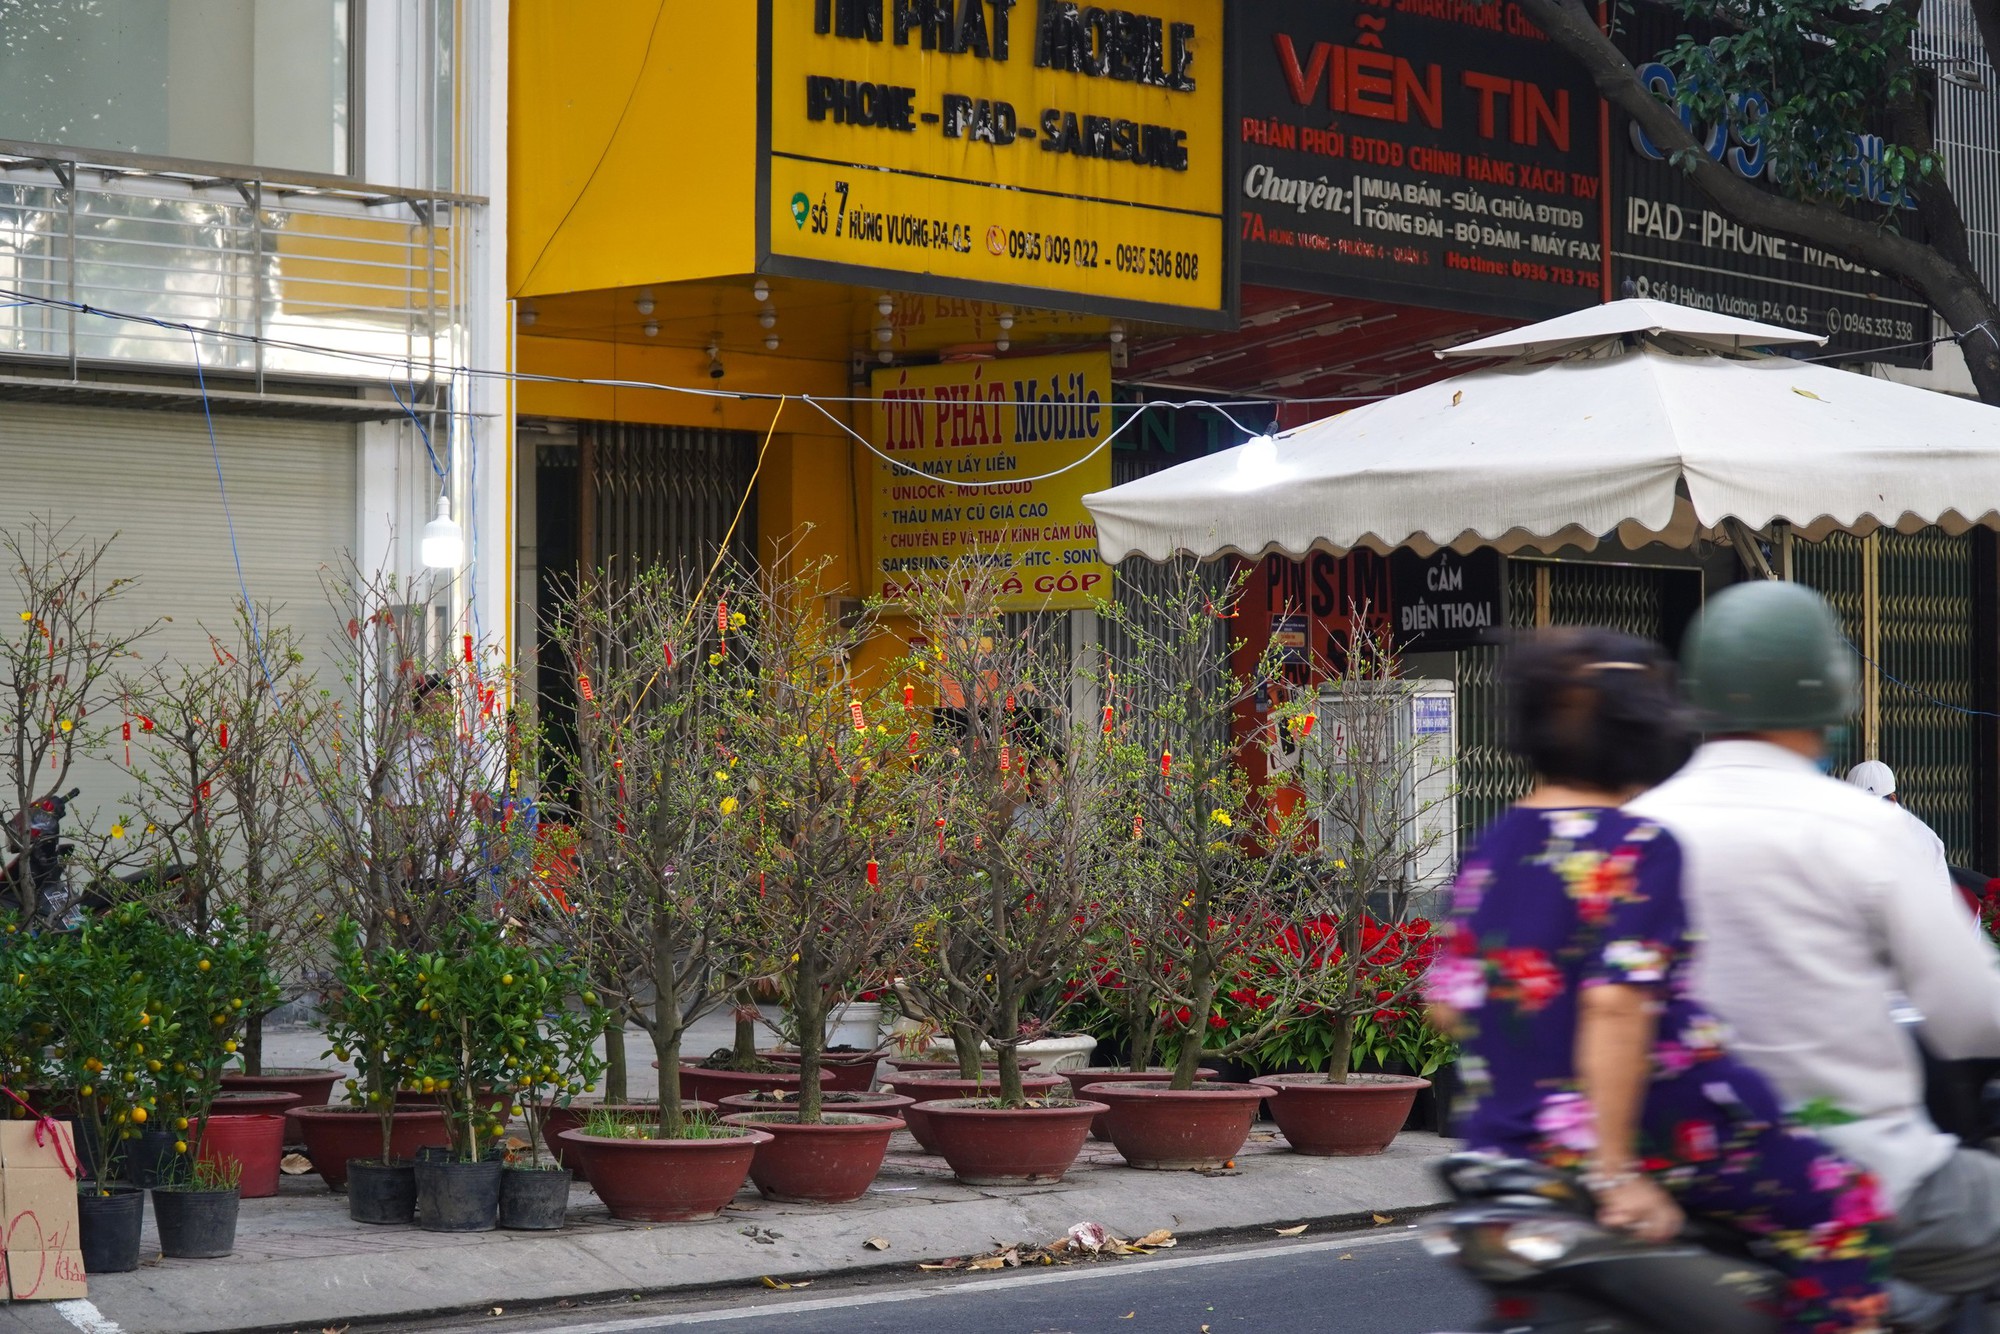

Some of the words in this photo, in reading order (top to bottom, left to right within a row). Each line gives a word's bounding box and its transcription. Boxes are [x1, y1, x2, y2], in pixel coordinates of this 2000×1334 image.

[1274, 13, 1443, 129] VIỄN
[1461, 69, 1570, 151] TIN
[806, 75, 916, 133] IPHONE
[942, 94, 1016, 145] IPAD
[1040, 109, 1188, 171] SAMSUNG
[1242, 117, 1296, 149] PHÂN
[1301, 122, 1345, 157] PHỐI
[1409, 144, 1462, 177] CHÍNH
[1467, 152, 1514, 187] HÀNG
[1519, 161, 1565, 193] XÁCH
[1571, 174, 1600, 200] TAY
[835, 181, 849, 237] 7
[1362, 177, 1402, 201] MUA
[1407, 181, 1442, 208] BÁN
[1452, 187, 1487, 214] SỬA
[1490, 195, 1535, 222] CHỮA
[1241, 211, 1267, 242] 7A
[1364, 202, 1412, 234] TỔNG
[1414, 211, 1444, 239] ĐÀI
[1455, 219, 1480, 250] BỘ
[1482, 222, 1521, 250] ĐÀM
[1530, 231, 1568, 256] MÁY
[1568, 239, 1602, 262] FAX
[1627, 196, 1683, 241] IPAD
[1044, 234, 1071, 265] 009
[1073, 239, 1098, 268] 022
[1149, 248, 1172, 278] 506
[1175, 252, 1199, 281] 808
[1652, 280, 1669, 301] Số
[1671, 288, 1678, 302] 9
[1843, 313, 1873, 335] 0945
[1875, 317, 1893, 338] 333
[1895, 320, 1913, 341] 338
[882, 370, 925, 450] TÍN
[934, 364, 1006, 448] PHÁT
[1013, 372, 1100, 443] Mobile
[922, 456, 953, 475] MÁY
[957, 453, 981, 473] LẤY
[892, 484, 945, 500] UNLOCK
[892, 506, 927, 524] THÂU
[932, 504, 962, 523] MÁY
[990, 500, 1015, 519] GIÁ
[1019, 503, 1048, 518] CAO
[890, 529, 943, 548] CHUYÊN
[883, 556, 949, 572] SAMSUNG
[1025, 551, 1051, 566] HTC
[1063, 549, 1099, 565] SONY
[1034, 570, 1102, 594] GÓP
[1441, 601, 1492, 634] THOẠI
